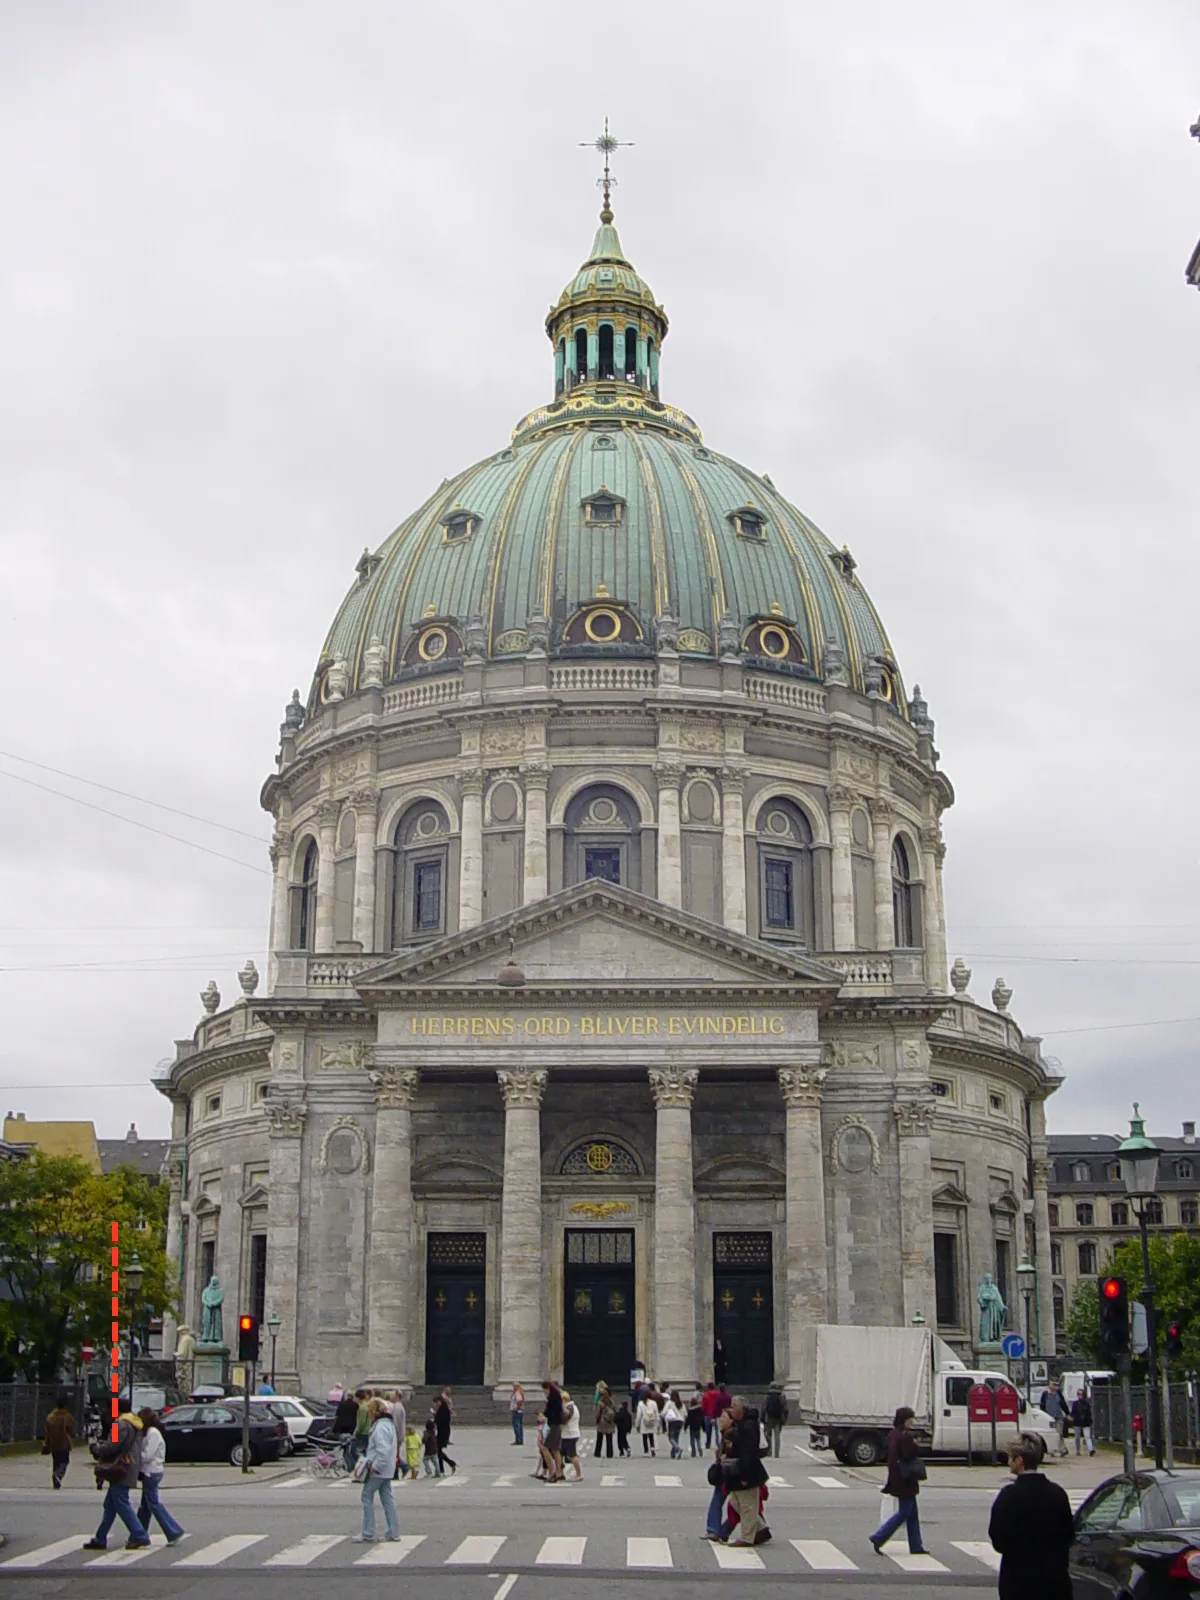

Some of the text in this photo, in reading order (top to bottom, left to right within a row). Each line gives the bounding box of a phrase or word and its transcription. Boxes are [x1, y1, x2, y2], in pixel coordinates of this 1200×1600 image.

[412, 1016, 785, 1035] HERRENS ORD BLIVER EVINDELIG
